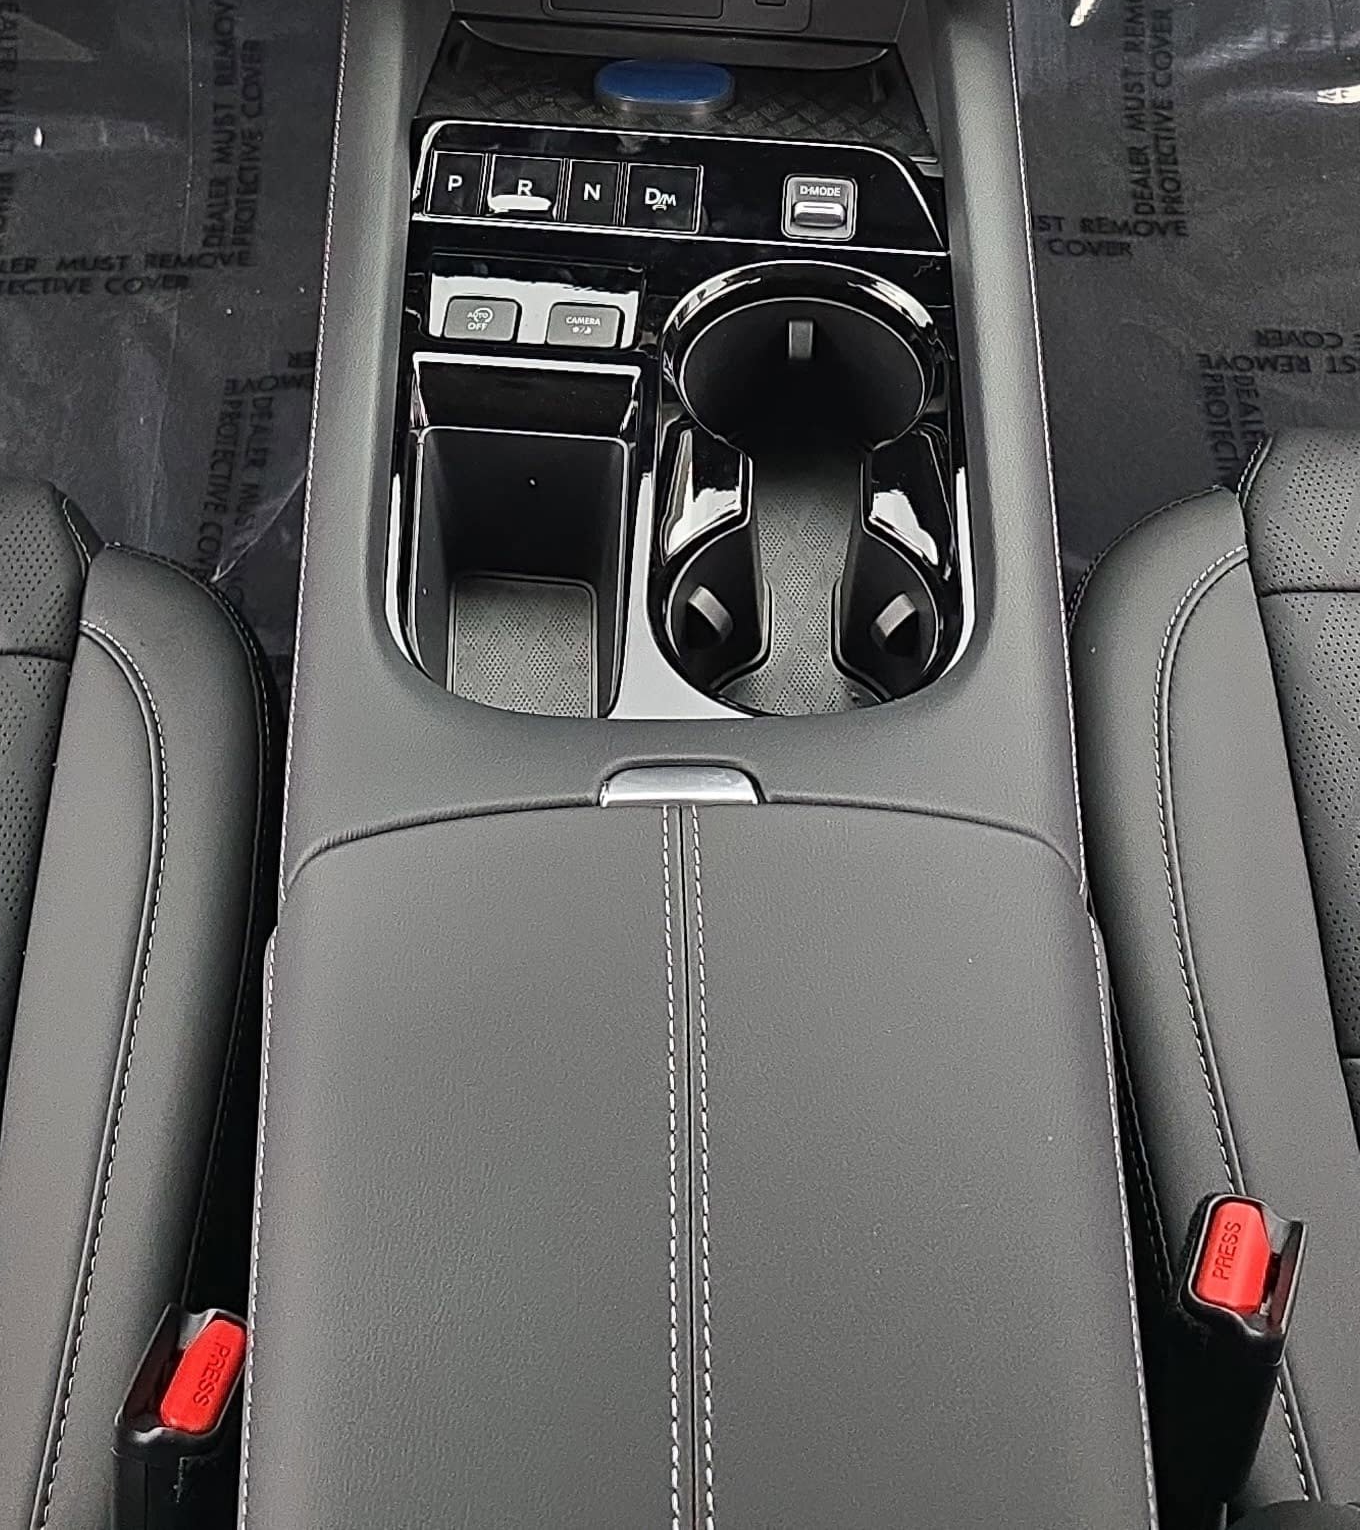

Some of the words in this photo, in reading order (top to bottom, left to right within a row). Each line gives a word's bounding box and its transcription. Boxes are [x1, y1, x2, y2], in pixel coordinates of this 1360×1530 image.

[1150, 9, 1174, 89] COVER
[1122, 68, 1146, 132] MUST
[210, 102, 237, 165] MUST
[1151, 98, 1186, 216] PROTECTIVE
[447, 174, 463, 192] P
[517, 178, 534, 197] R
[1128, 144, 1156, 216] DEALER
[582, 182, 601, 202] N
[1079, 217, 1189, 238] REMOVE
[1047, 238, 1134, 258] COVER
[55, 253, 133, 273] MUST
[143, 249, 259, 269] REMOVE
[103, 274, 191, 297] COVER
[467, 321, 489, 332] OFF
[565, 315, 602, 327] CAMERA
[1254, 328, 1344, 351] COVER
[1196, 353, 1312, 375] REMOVE
[1211, 1220, 1243, 1282] PRESS
[192, 1341, 232, 1408] PRESS
